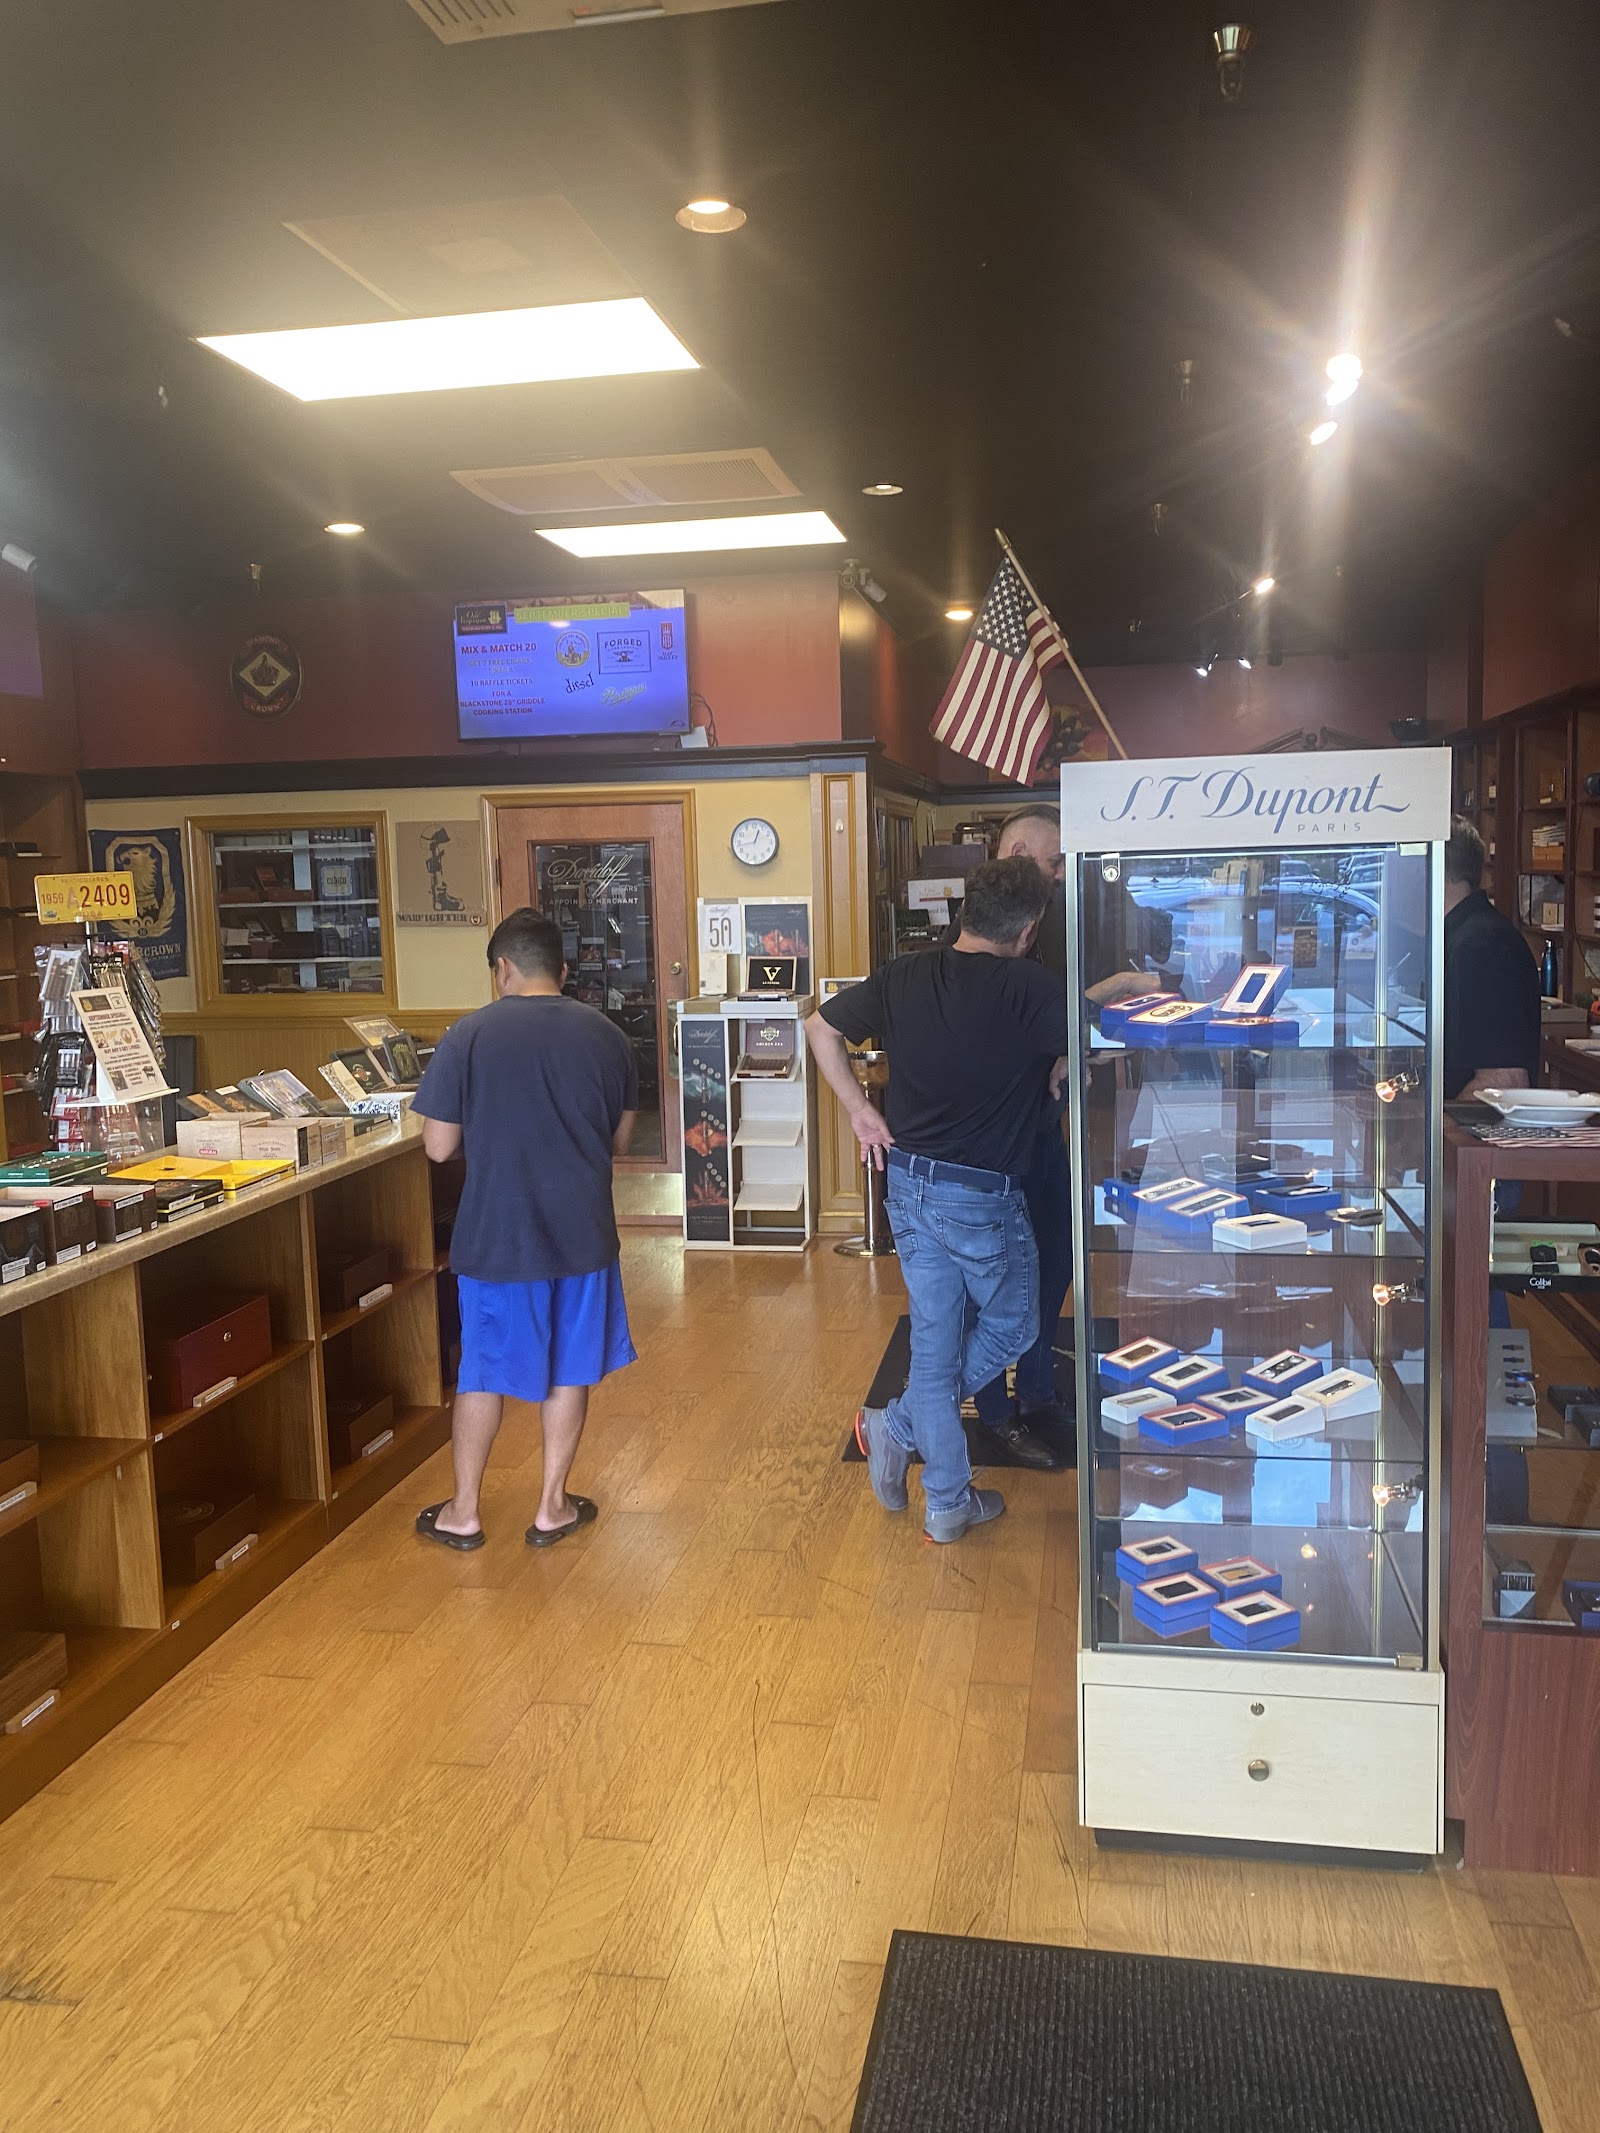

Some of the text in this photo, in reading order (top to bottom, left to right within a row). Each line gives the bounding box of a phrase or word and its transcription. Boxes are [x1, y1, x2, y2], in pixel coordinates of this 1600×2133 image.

[461, 643, 537, 654] MIX & MATCH 20
[604, 638, 643, 650] FORGED
[471, 677, 533, 687] 10 RAFFLE TICKETS
[565, 671, 595, 694] diesel
[460, 699, 503, 708] BLACKSTONE
[517, 697, 546, 706] GRIDDLE
[473, 706, 533, 716] COOKING STATION
[1100, 766, 1411, 834] S.T. Dupont
[1297, 822, 1362, 833] PARIS
[547, 853, 633, 899] Davidoff
[41, 892, 65, 905] 1959
[79, 883, 130, 908] 2409
[595, 897, 638, 905] MERCHANT
[398, 914, 468, 922] WARFIGHTER
[136, 942, 181, 957] RCROWN
